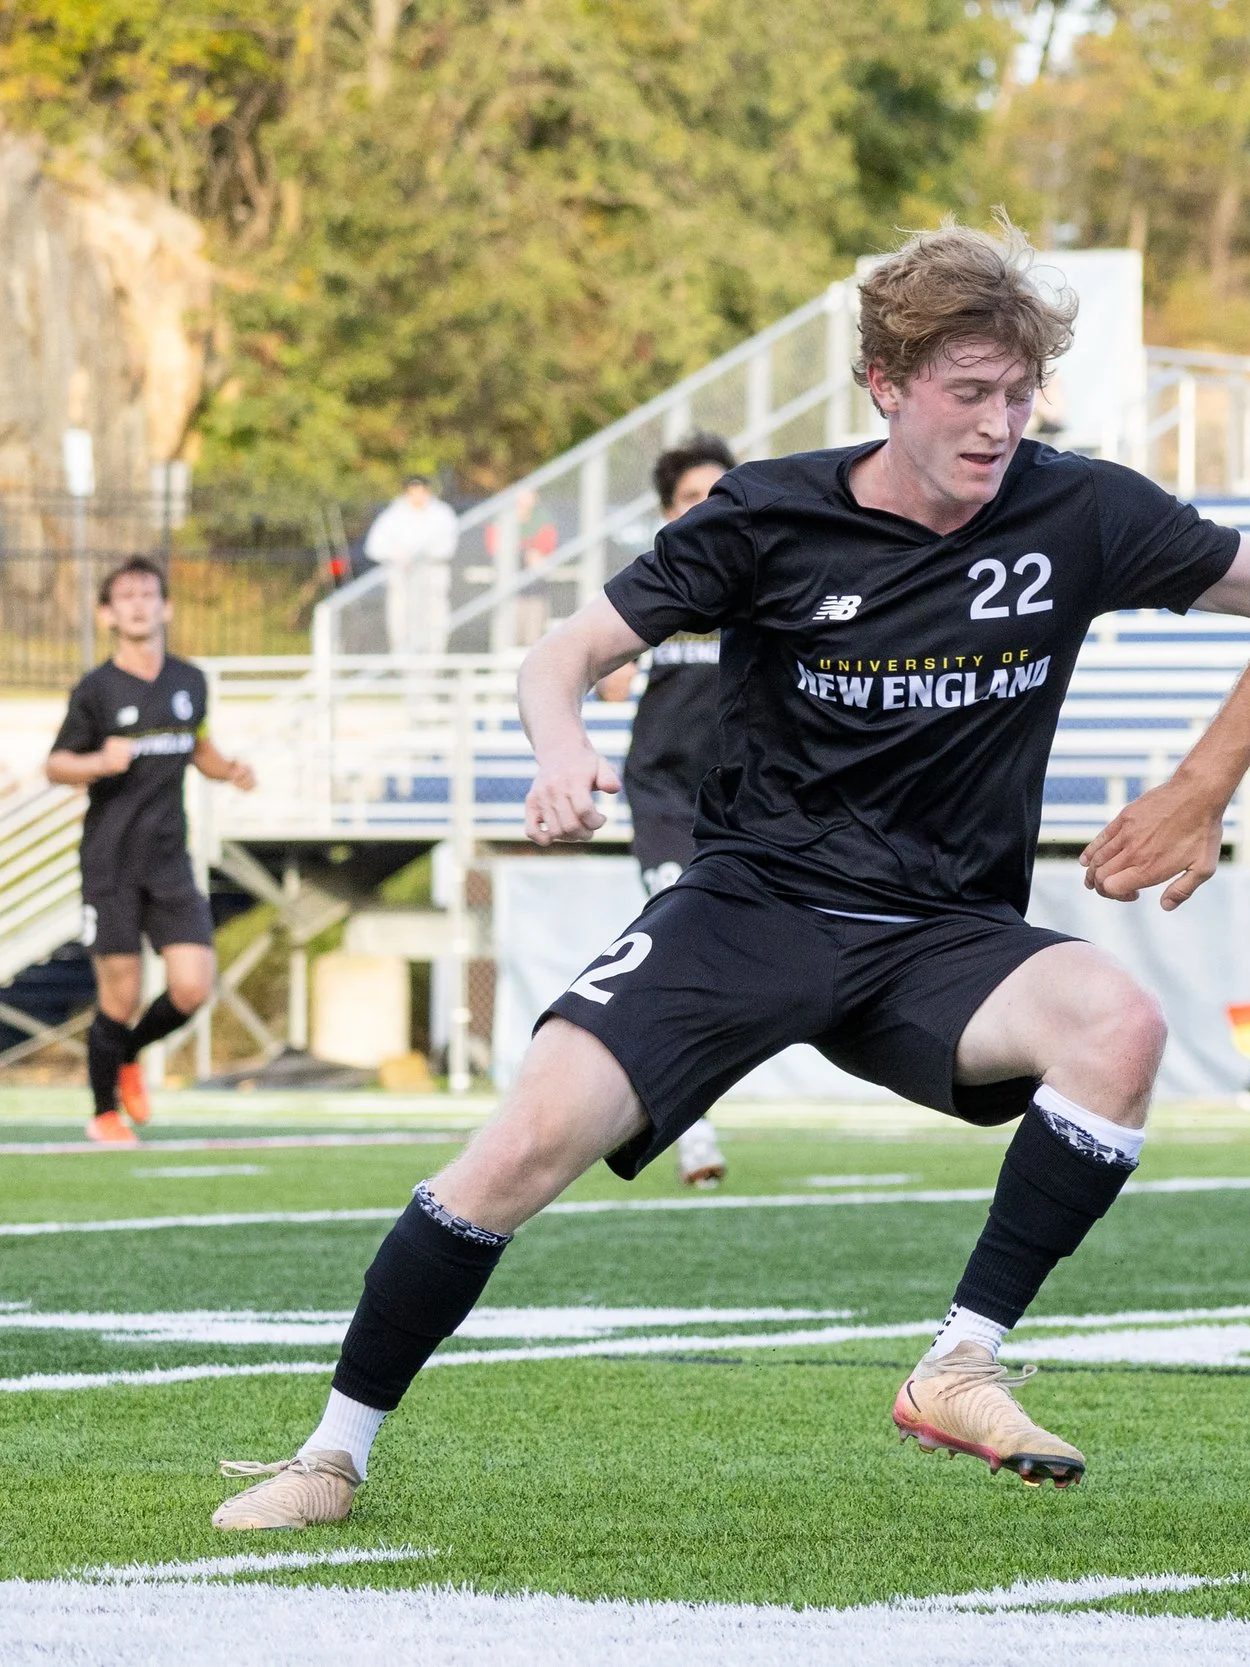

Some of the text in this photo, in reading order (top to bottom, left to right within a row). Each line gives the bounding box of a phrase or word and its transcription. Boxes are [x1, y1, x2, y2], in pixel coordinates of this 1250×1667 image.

[967, 552, 1054, 620] 22
[797, 654, 1052, 710] NEW ENGLAND
[819, 649, 1030, 673] UNIVERSITY OF
